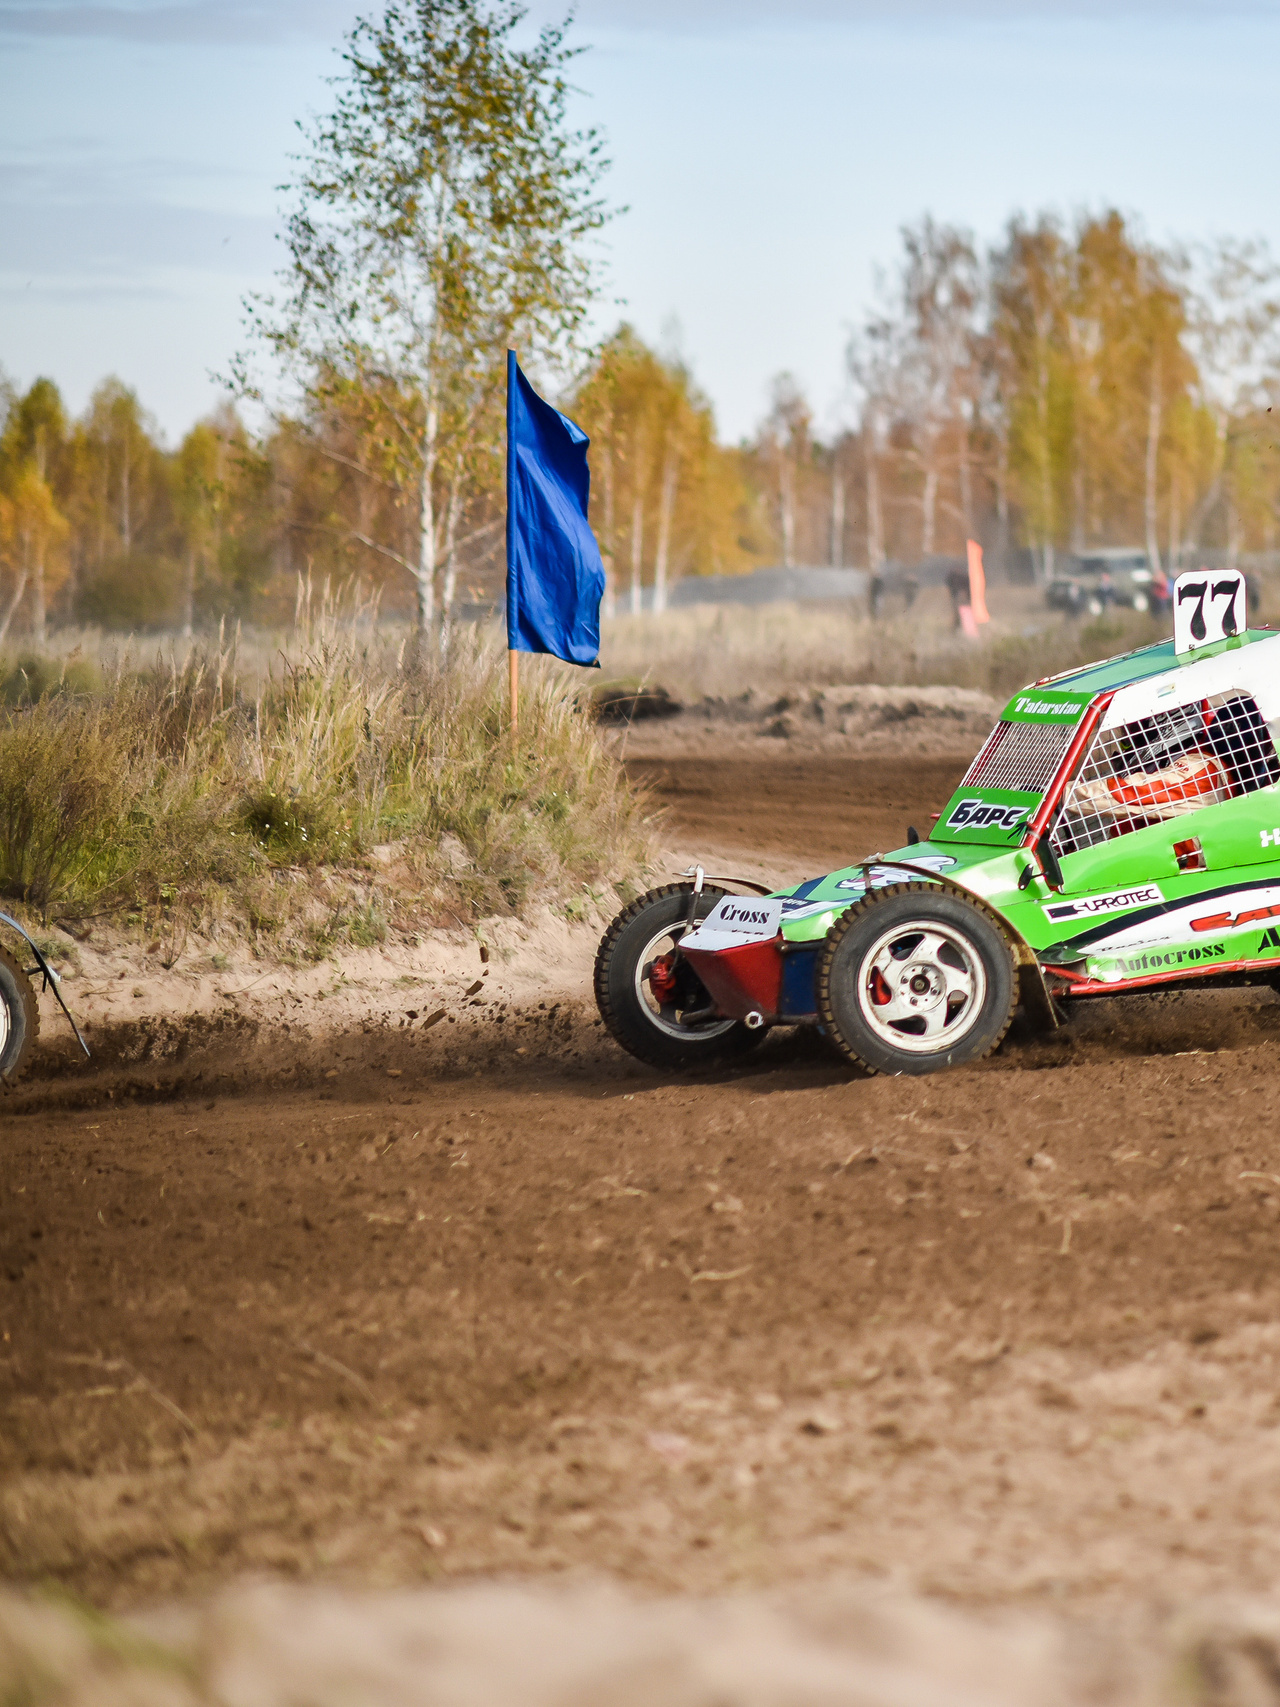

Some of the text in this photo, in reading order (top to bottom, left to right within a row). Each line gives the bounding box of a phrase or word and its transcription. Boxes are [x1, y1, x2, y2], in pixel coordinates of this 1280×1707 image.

[1178, 578, 1240, 640] 77
[1014, 697, 1082, 714] Tatarstan
[946, 799, 1031, 834] БАРС
[720, 904, 770, 924] Cross
[1072, 888, 1160, 912] SUPROTEC
[1113, 942, 1226, 974] Autocross
